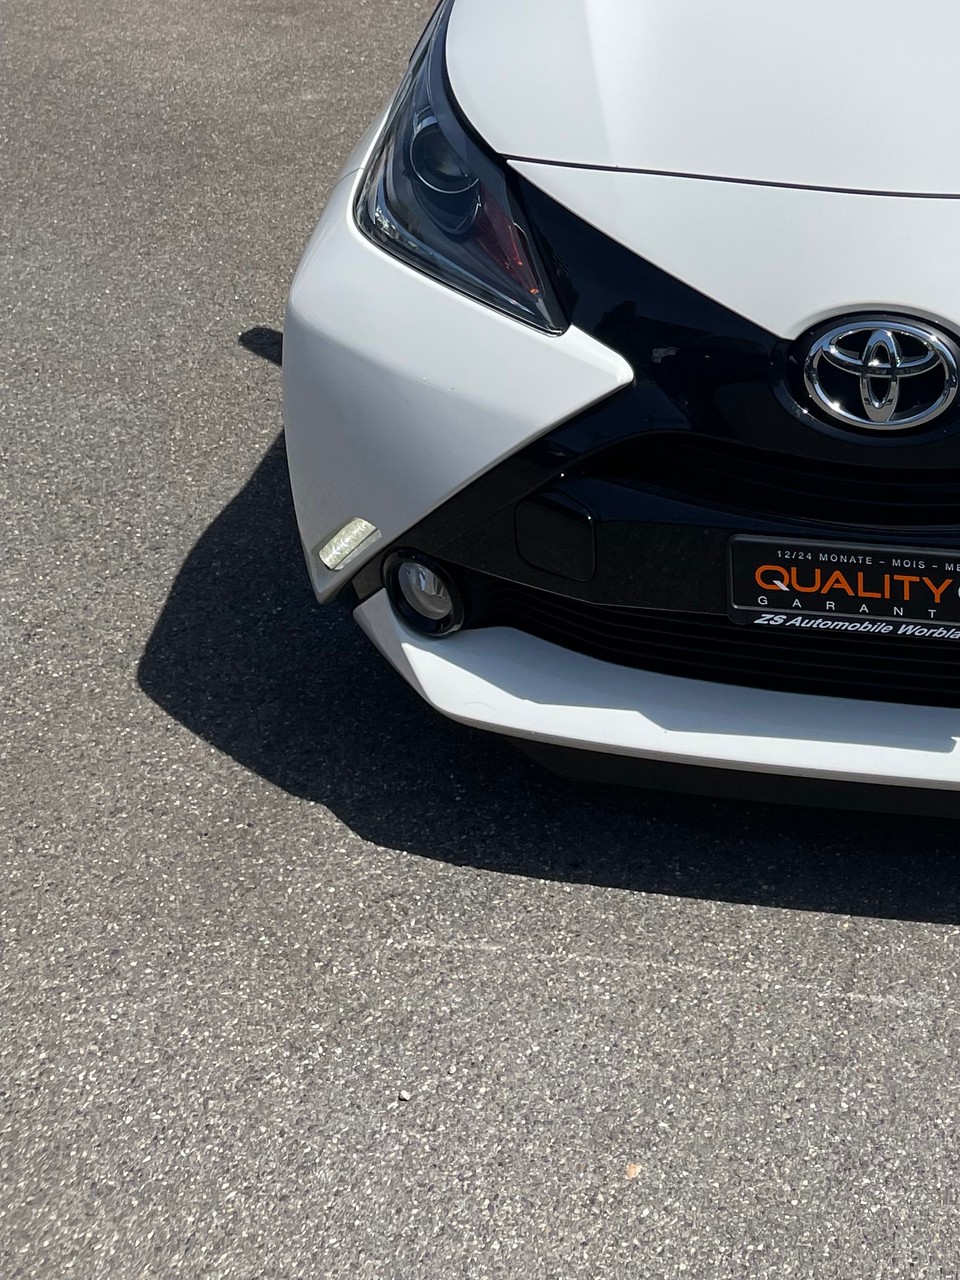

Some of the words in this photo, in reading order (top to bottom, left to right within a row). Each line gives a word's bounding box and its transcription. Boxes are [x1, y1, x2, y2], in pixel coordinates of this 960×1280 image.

[776, 550, 812, 561] 12/24
[819, 552, 873, 565] MONATE
[891, 558, 926, 570] MOIS
[754, 564, 954, 604] QUALITY
[753, 613, 787, 627] ZS
[787, 615, 894, 634] Automobile
